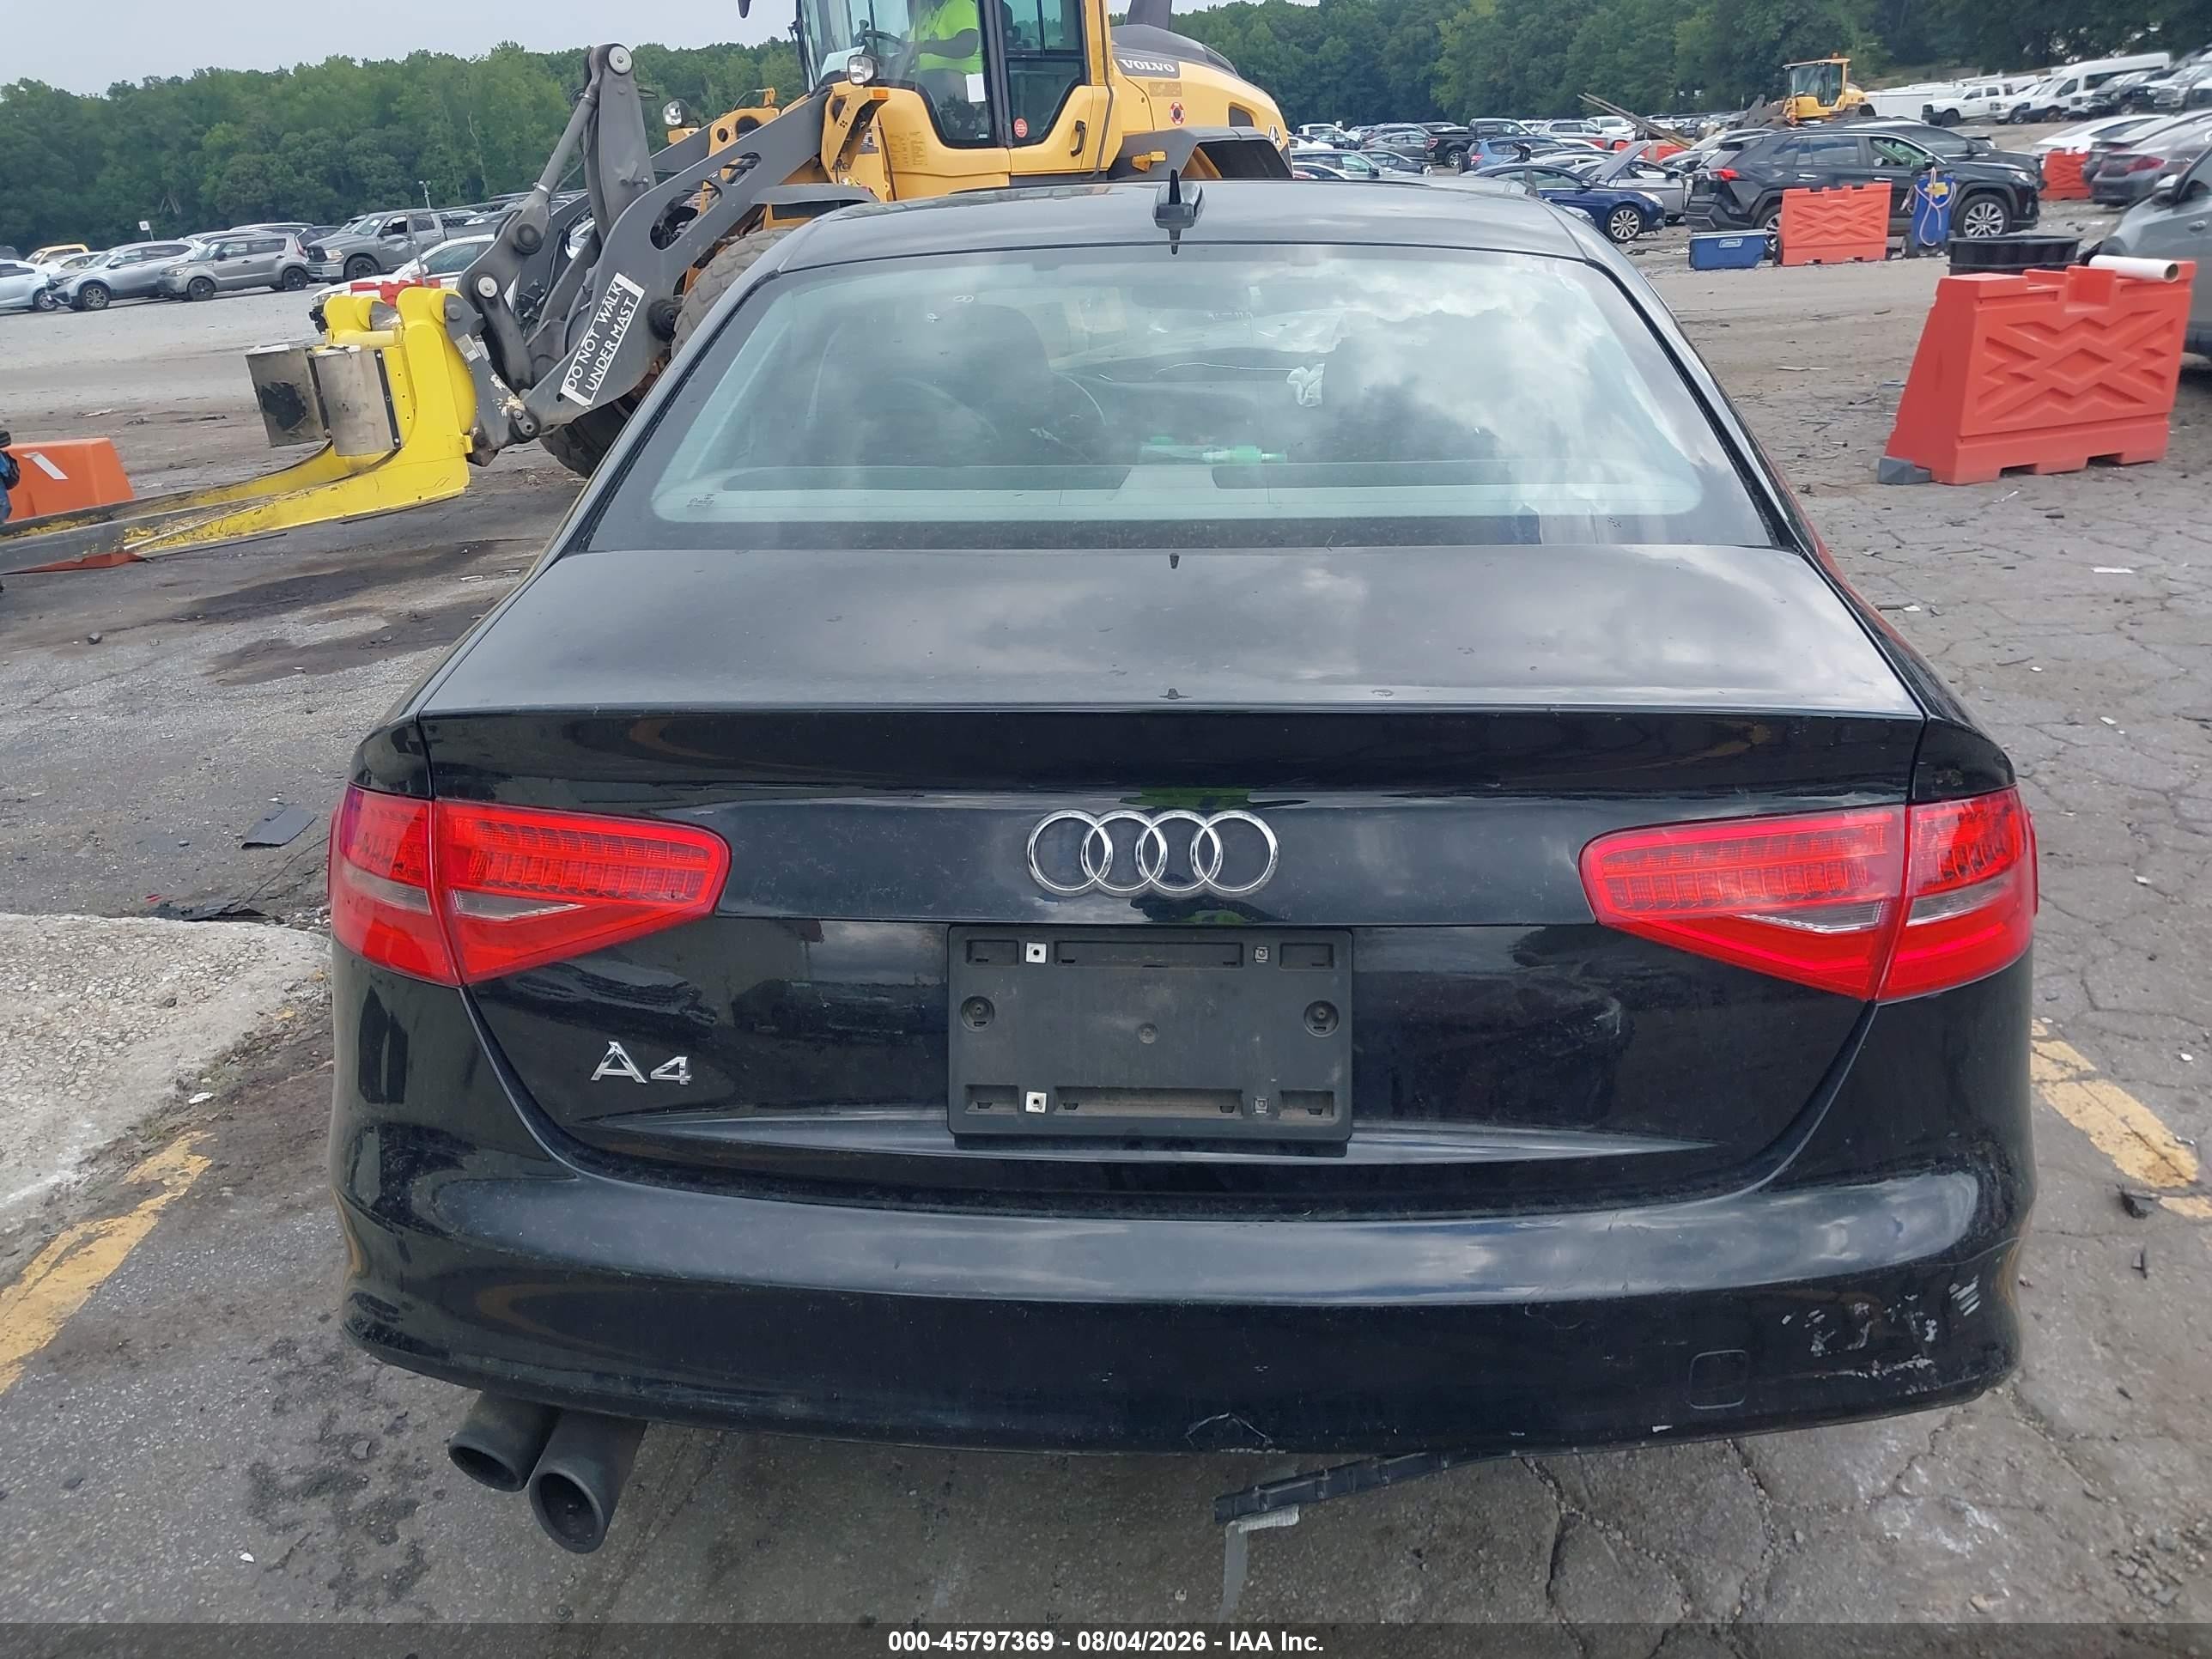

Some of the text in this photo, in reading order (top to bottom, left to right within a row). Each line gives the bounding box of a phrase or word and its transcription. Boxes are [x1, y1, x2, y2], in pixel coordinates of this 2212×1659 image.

[1119, 59, 1176, 72] VOLVO
[565, 282, 624, 391] DO NOT WALK
[585, 296, 635, 392] UNDER MAST
[590, 1040, 692, 1086] A4
